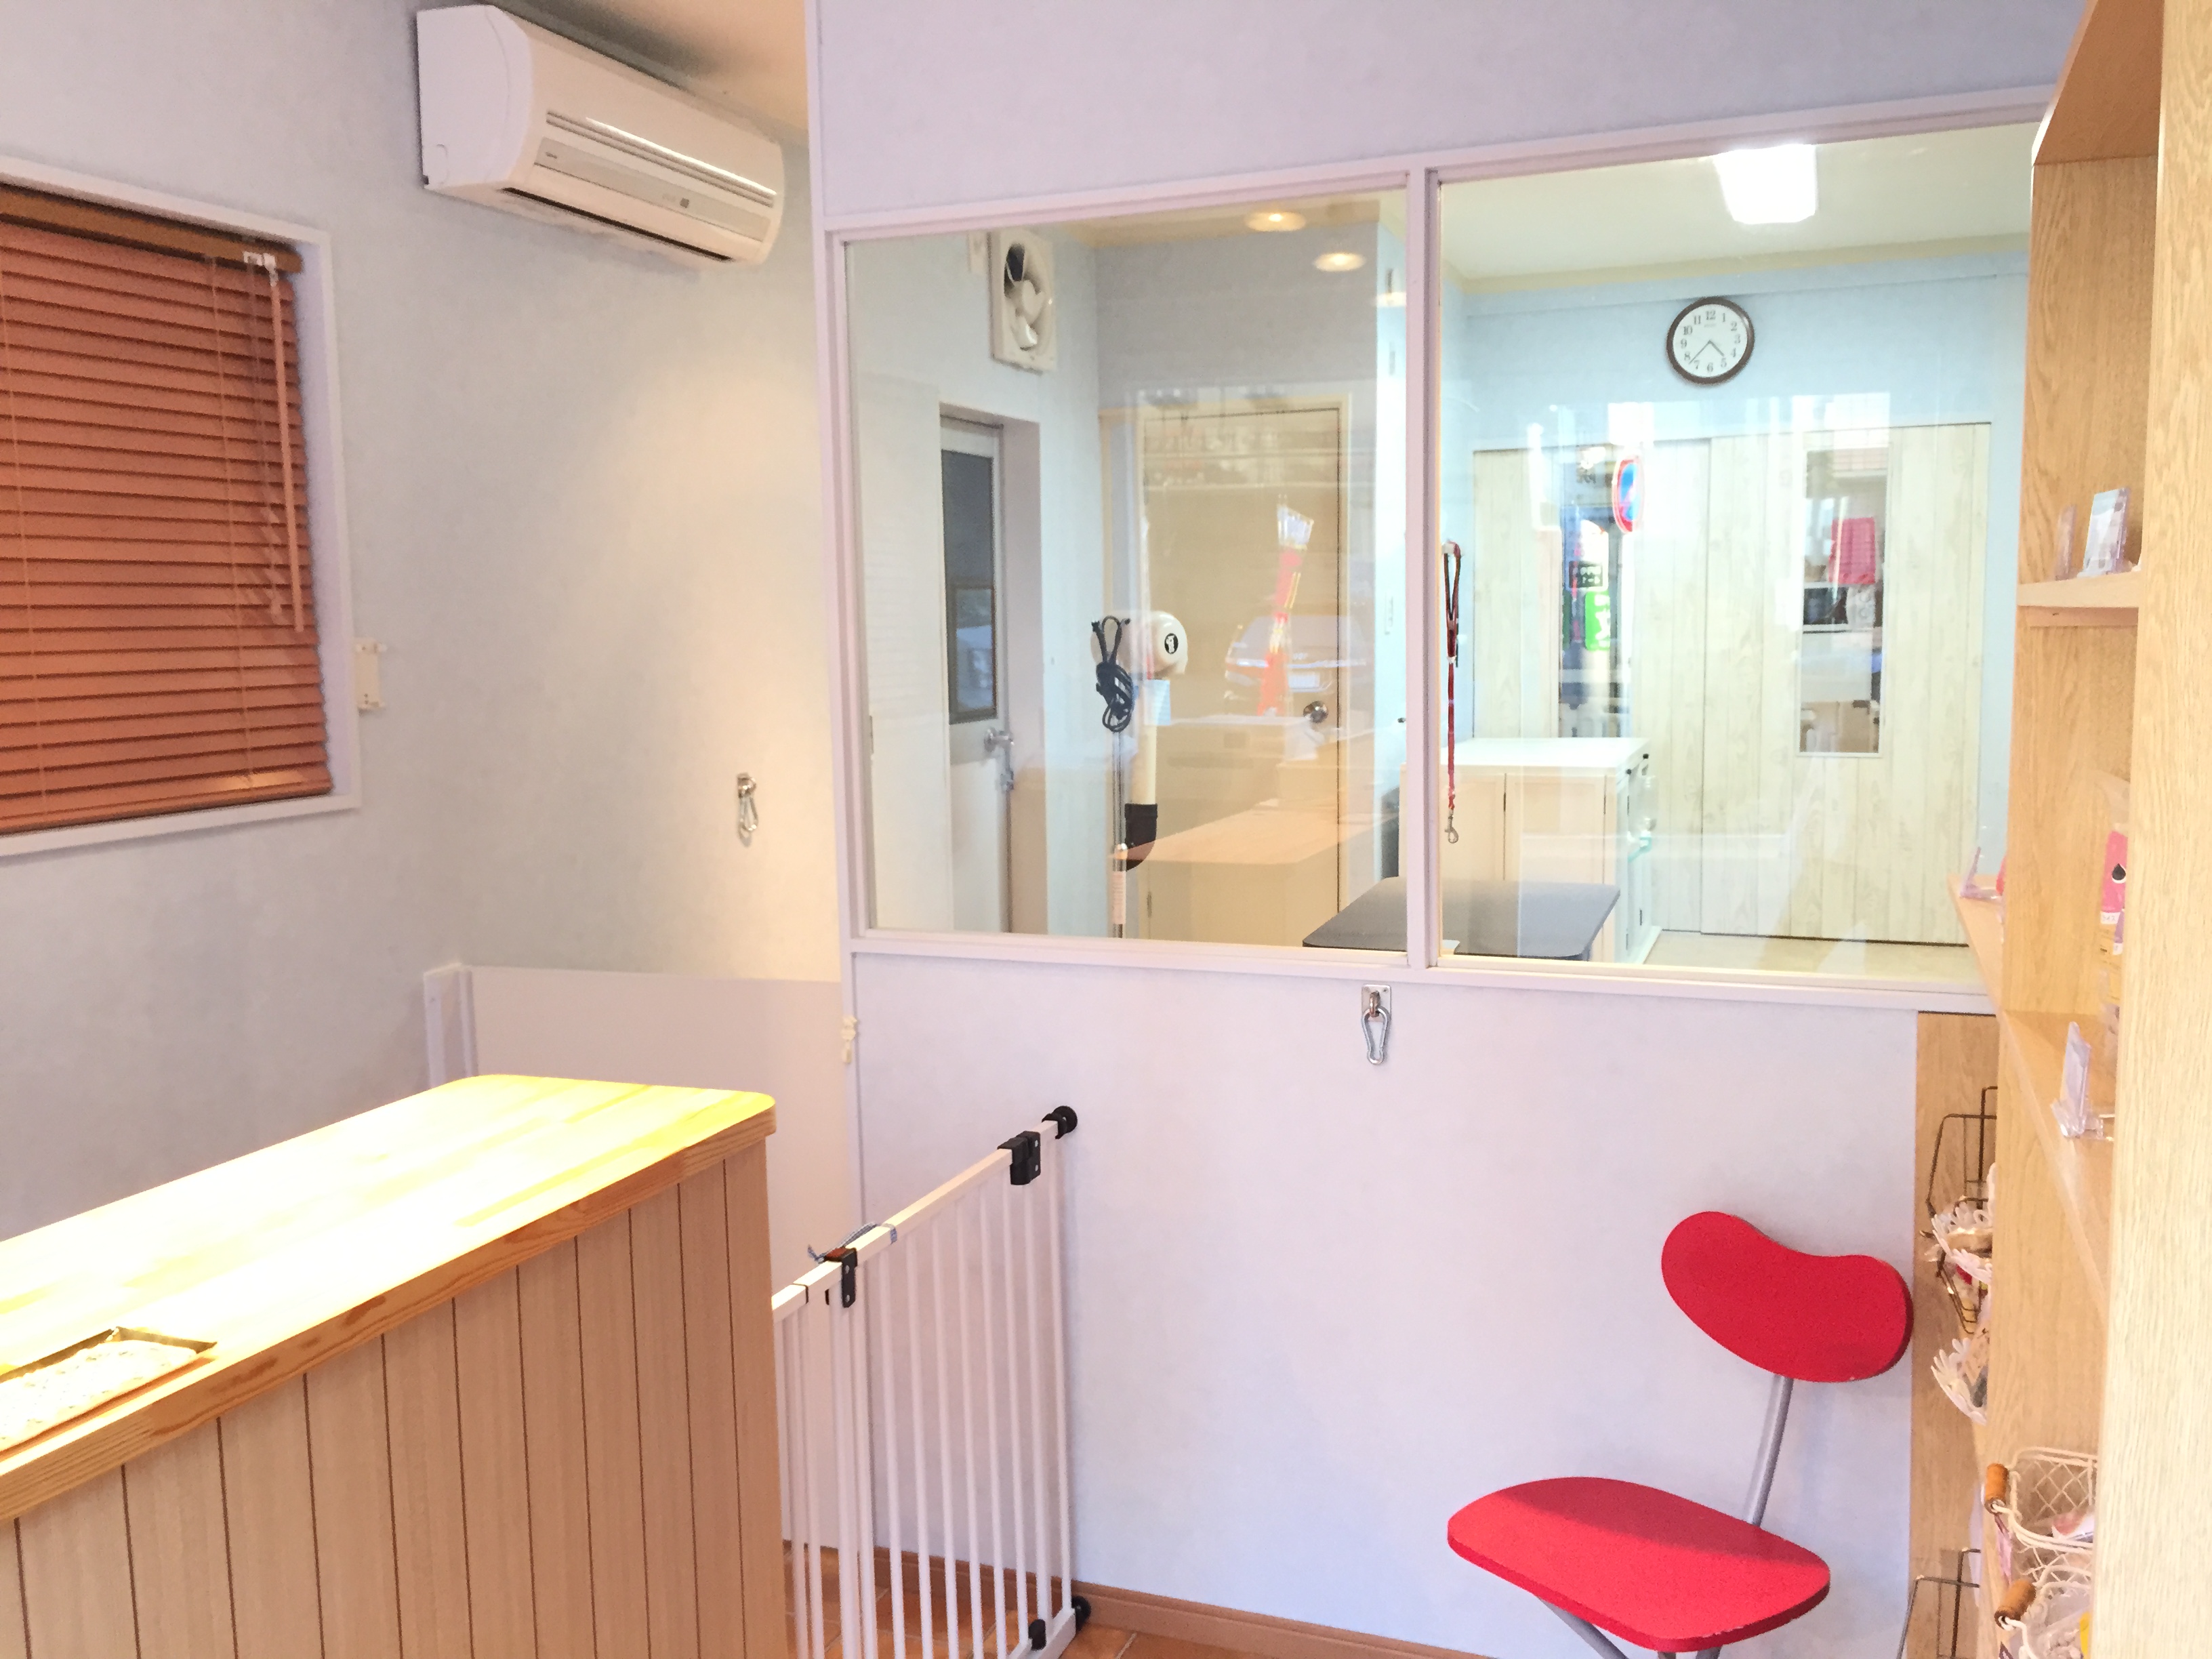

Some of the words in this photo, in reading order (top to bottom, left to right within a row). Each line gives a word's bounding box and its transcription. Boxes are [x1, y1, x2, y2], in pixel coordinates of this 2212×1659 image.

[1694, 315, 1700, 325] 11
[1706, 310, 1715, 320] 12
[1683, 325, 1692, 335] 10
[1731, 321, 1737, 331] 2
[1681, 339, 1687, 348] 9
[1734, 333, 1741, 344] 3
[1684, 351, 1690, 361] 8
[1694, 360, 1700, 369] 7
[1706, 363, 1713, 372] 6
[1721, 358, 1727, 367] 5
